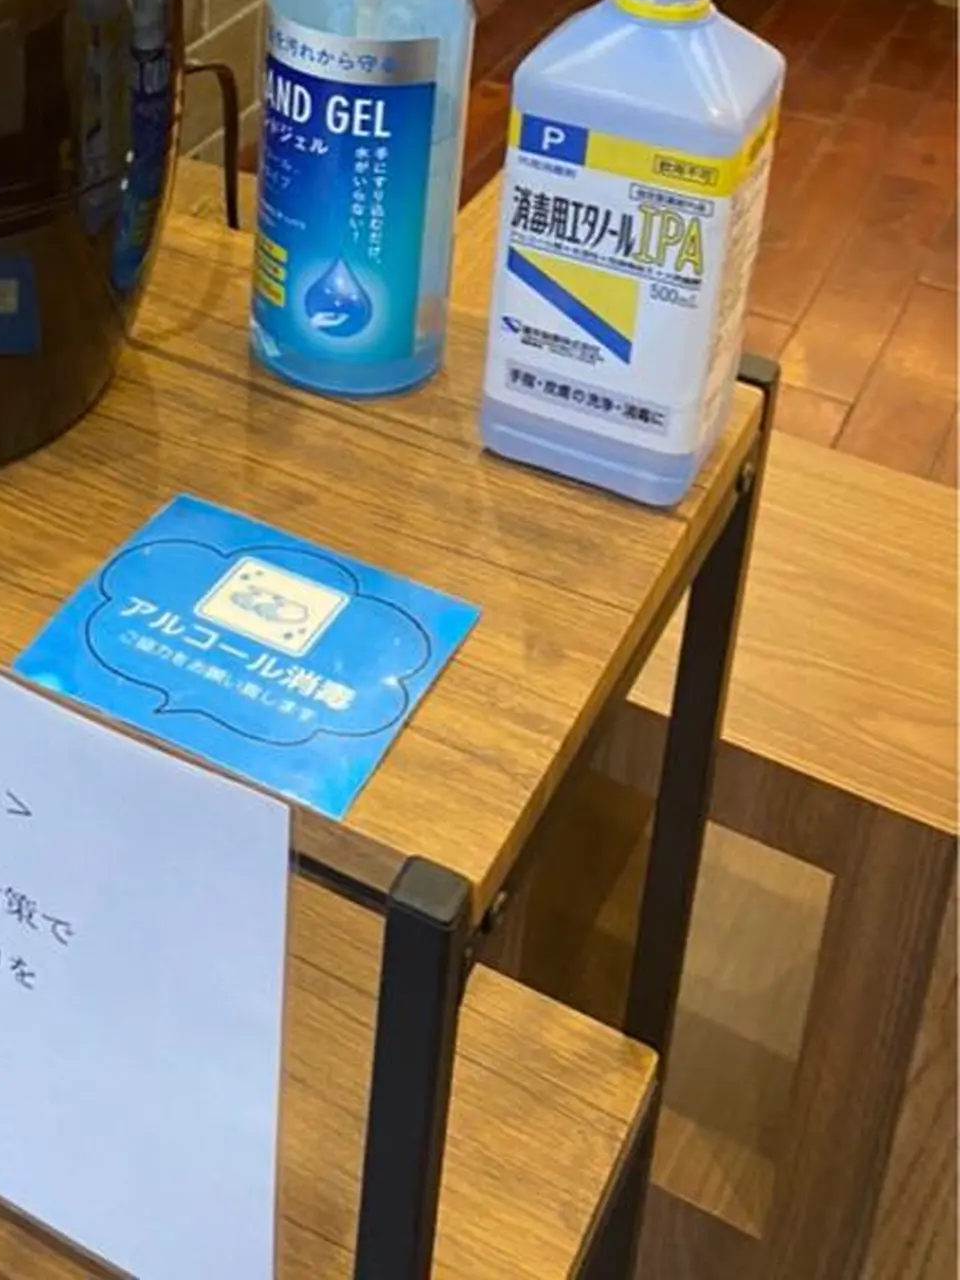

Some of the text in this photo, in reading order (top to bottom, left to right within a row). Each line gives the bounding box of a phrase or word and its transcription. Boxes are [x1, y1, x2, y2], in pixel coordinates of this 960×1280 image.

[264, 70, 392, 139] AND GEL
[542, 125, 566, 152] P
[120, 596, 357, 710] アルコール消毒
